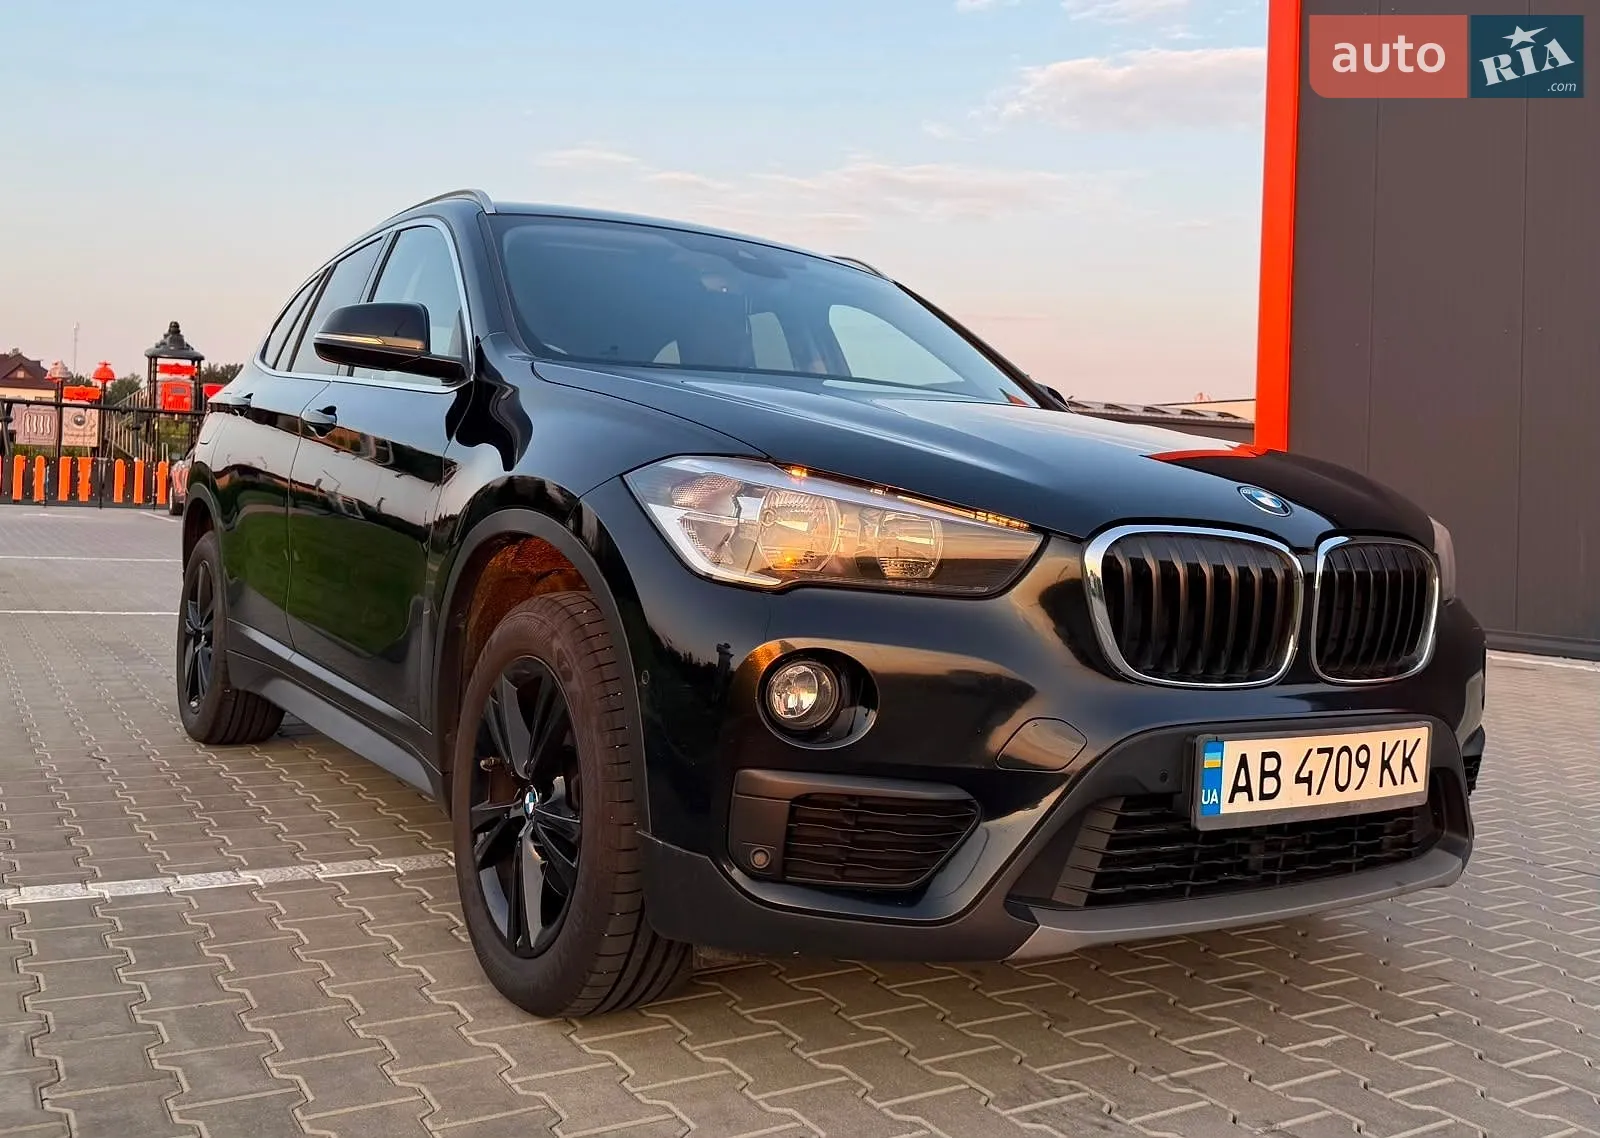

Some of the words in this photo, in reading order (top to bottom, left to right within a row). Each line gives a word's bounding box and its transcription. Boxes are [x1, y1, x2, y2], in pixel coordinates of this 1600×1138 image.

[1228, 751, 1282, 804] AB
[1294, 744, 1371, 796] 4709
[1379, 737, 1421, 788] KK
[1201, 789, 1219, 805] UA
